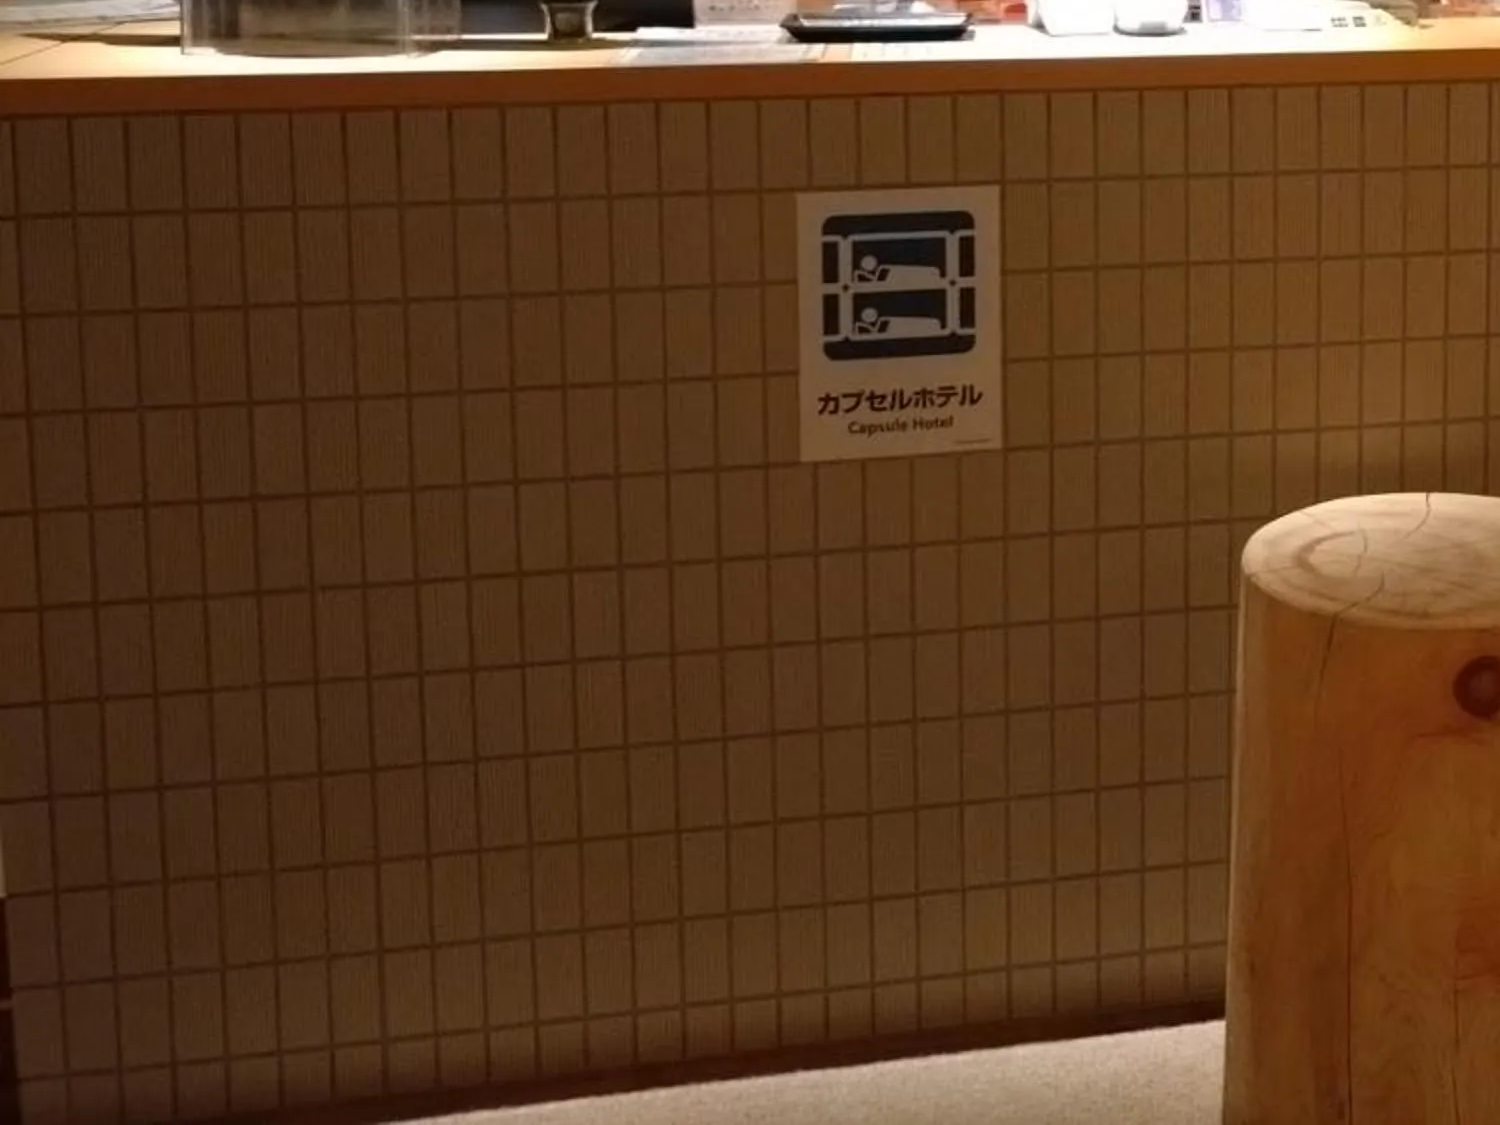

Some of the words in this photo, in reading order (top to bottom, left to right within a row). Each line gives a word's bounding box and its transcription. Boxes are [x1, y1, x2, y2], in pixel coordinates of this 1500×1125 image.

[817, 383, 984, 416] カプセルホテル
[847, 418, 908, 438] Capsule
[912, 414, 955, 430] Hotel
